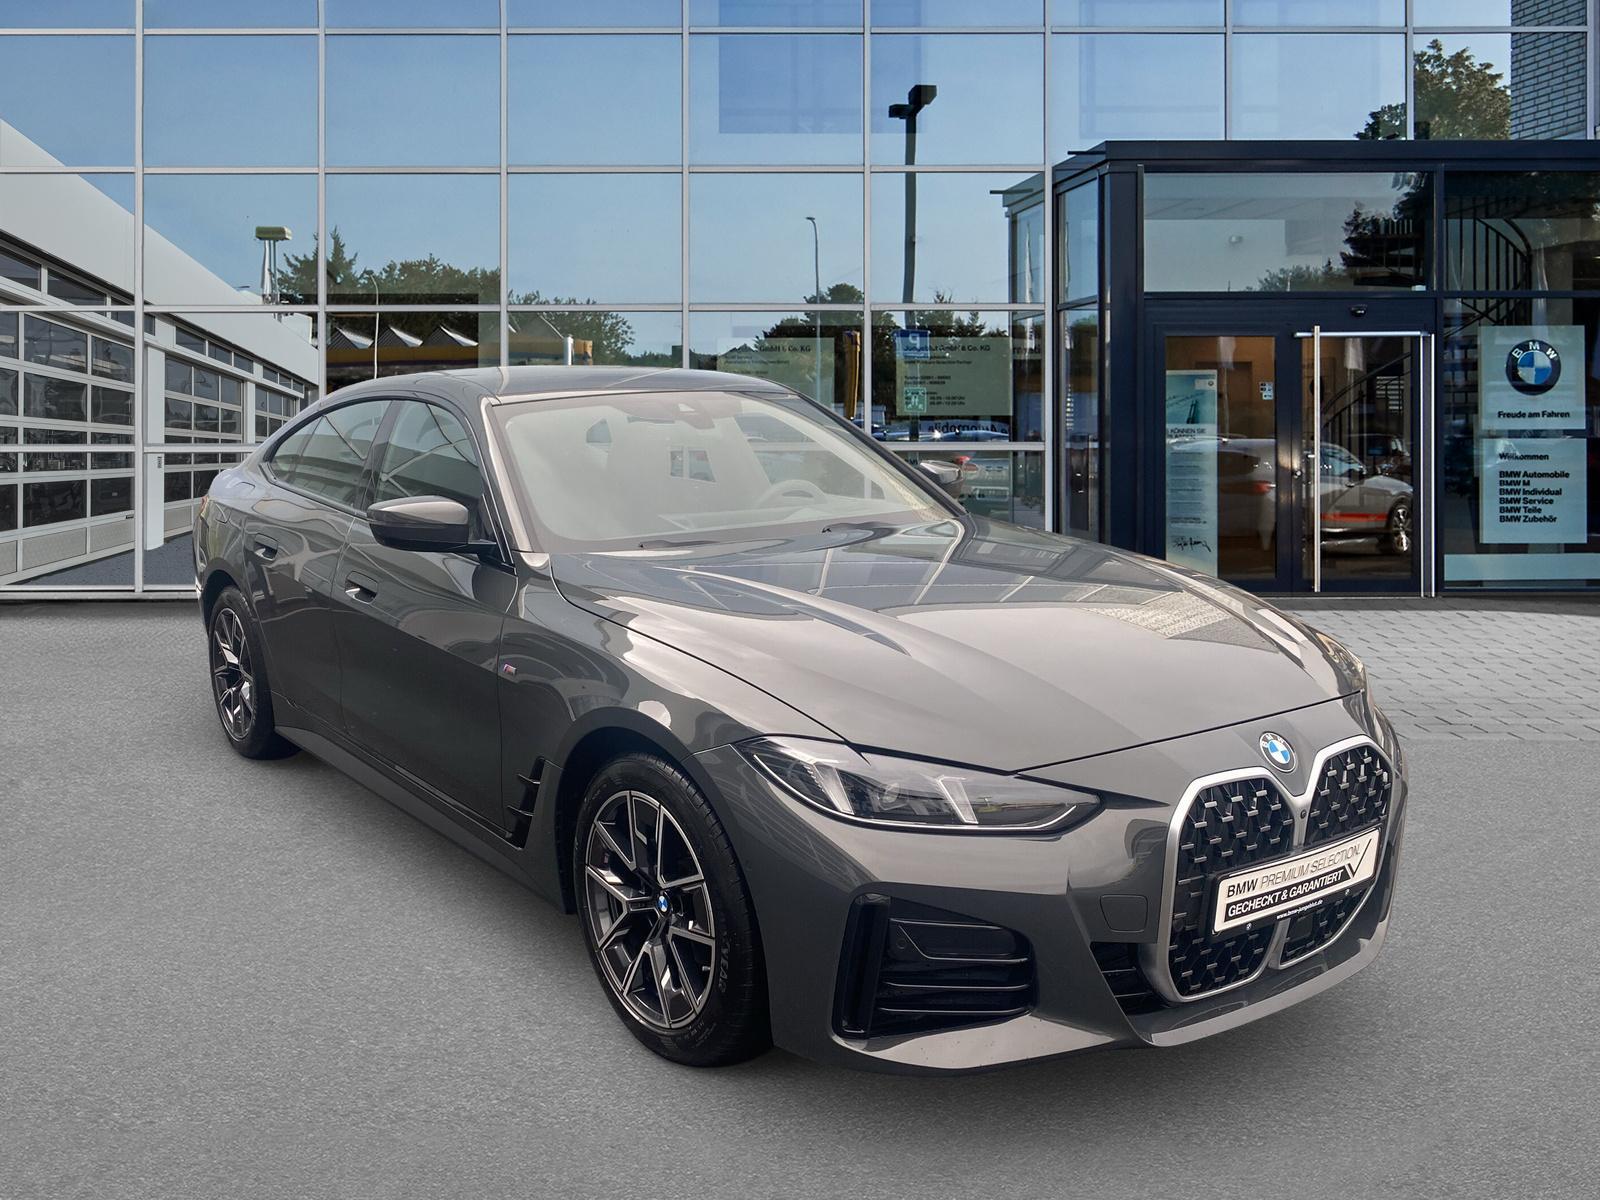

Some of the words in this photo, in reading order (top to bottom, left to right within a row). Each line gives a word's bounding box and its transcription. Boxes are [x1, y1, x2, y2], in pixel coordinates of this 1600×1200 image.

[800, 344, 811, 352] KG
[980, 344, 991, 352] KG
[1512, 341, 1558, 359] BMW
[1498, 411, 1527, 419] Freude
[1541, 411, 1570, 419] Fahren
[1499, 471, 1521, 479] BMW
[1522, 471, 1570, 479] Automobile
[1499, 488, 1521, 496] BMW
[1522, 488, 1562, 496] Individual
[1499, 497, 1521, 505] BMW
[1522, 497, 1554, 505] Service
[1499, 506, 1521, 514] BMW
[1522, 506, 1542, 514] Teile
[1499, 514, 1521, 523] BMW
[1522, 514, 1557, 523] Zubehör
[1227, 879, 1258, 898] BMW
[1260, 864, 1310, 889] PREMIUM
[1228, 891, 1281, 917] GECHECKT
[1281, 889, 1289, 901] &
[1289, 869, 1344, 898] GARANTIERT
